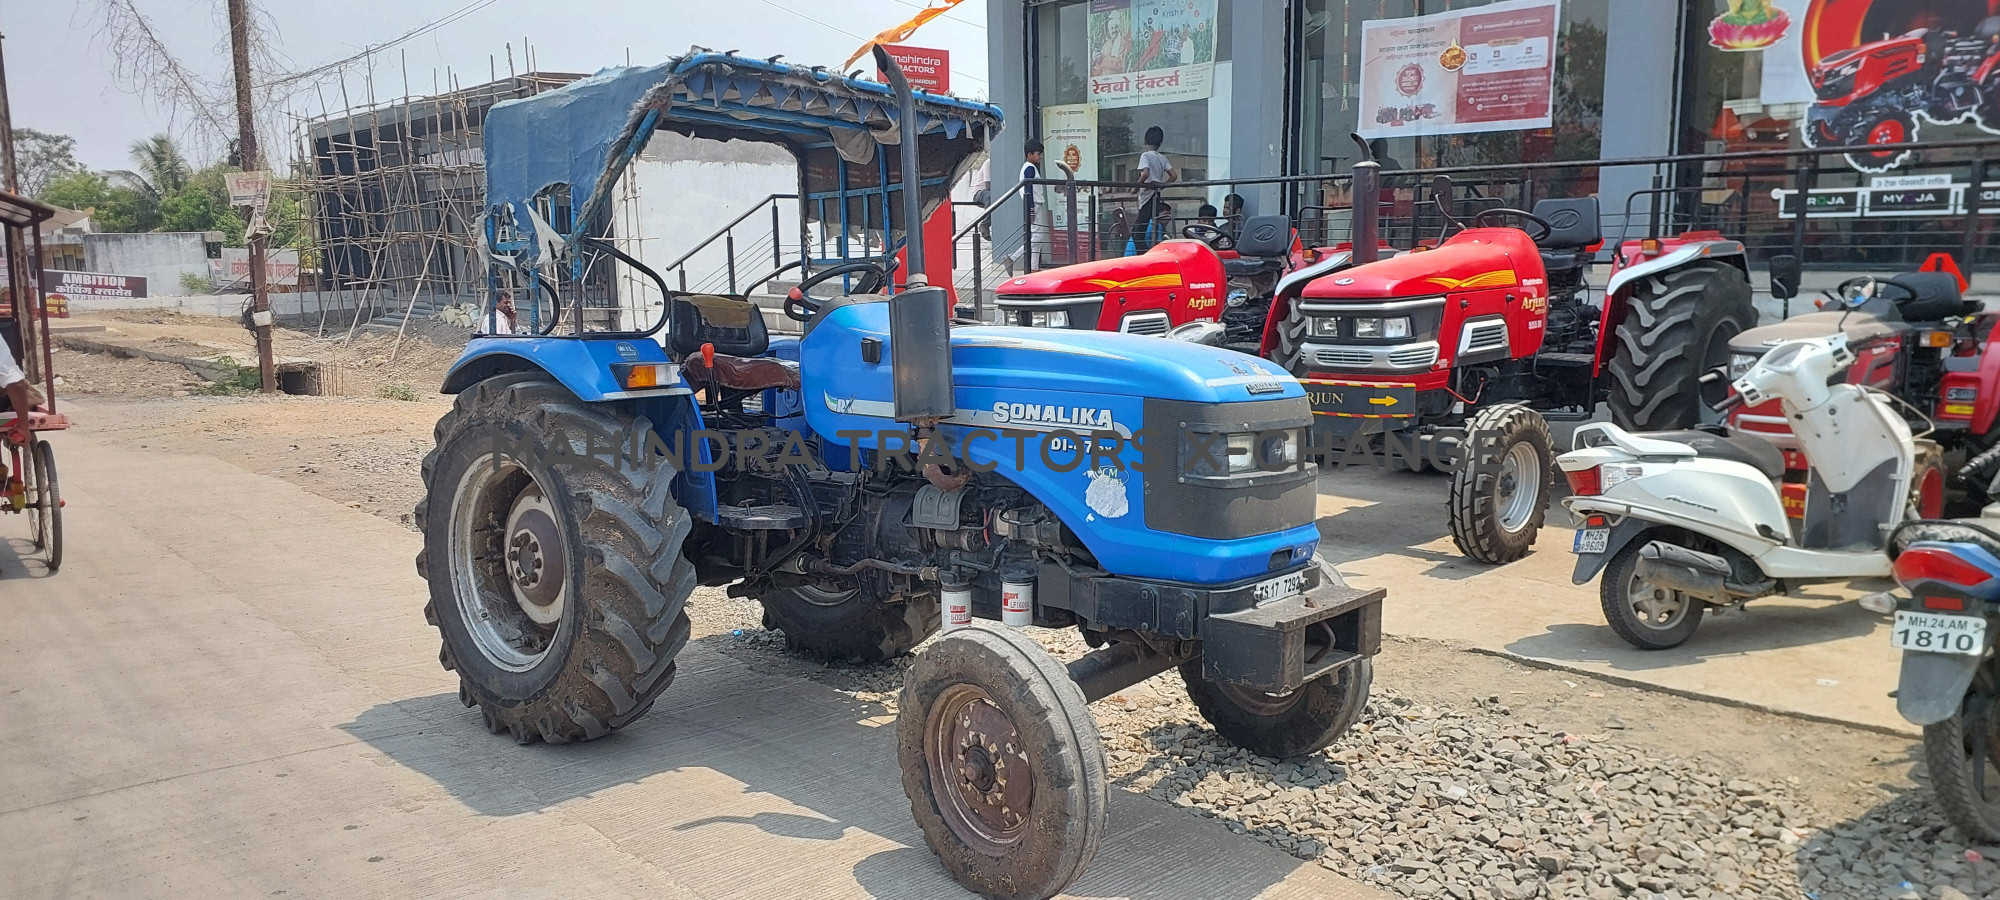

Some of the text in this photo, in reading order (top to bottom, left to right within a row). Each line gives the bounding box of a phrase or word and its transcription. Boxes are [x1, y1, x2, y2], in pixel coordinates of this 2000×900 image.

[891, 54, 941, 66] mahindra
[898, 65, 935, 74] RACTORS
[1092, 76, 1131, 95] रेनबो
[62, 273, 126, 287] AMBITION
[55, 283, 132, 297] कोचिंग क्लासेस
[1187, 295, 1217, 310] Arjun
[1520, 296, 1545, 311] Arjun
[1306, 391, 1345, 405] RJUN
[992, 401, 1114, 431] SONALIKA
[1584, 530, 1605, 541] MH26
[1908, 616, 1968, 631] MH.24.AM
[1897, 628, 1974, 651] 1810
